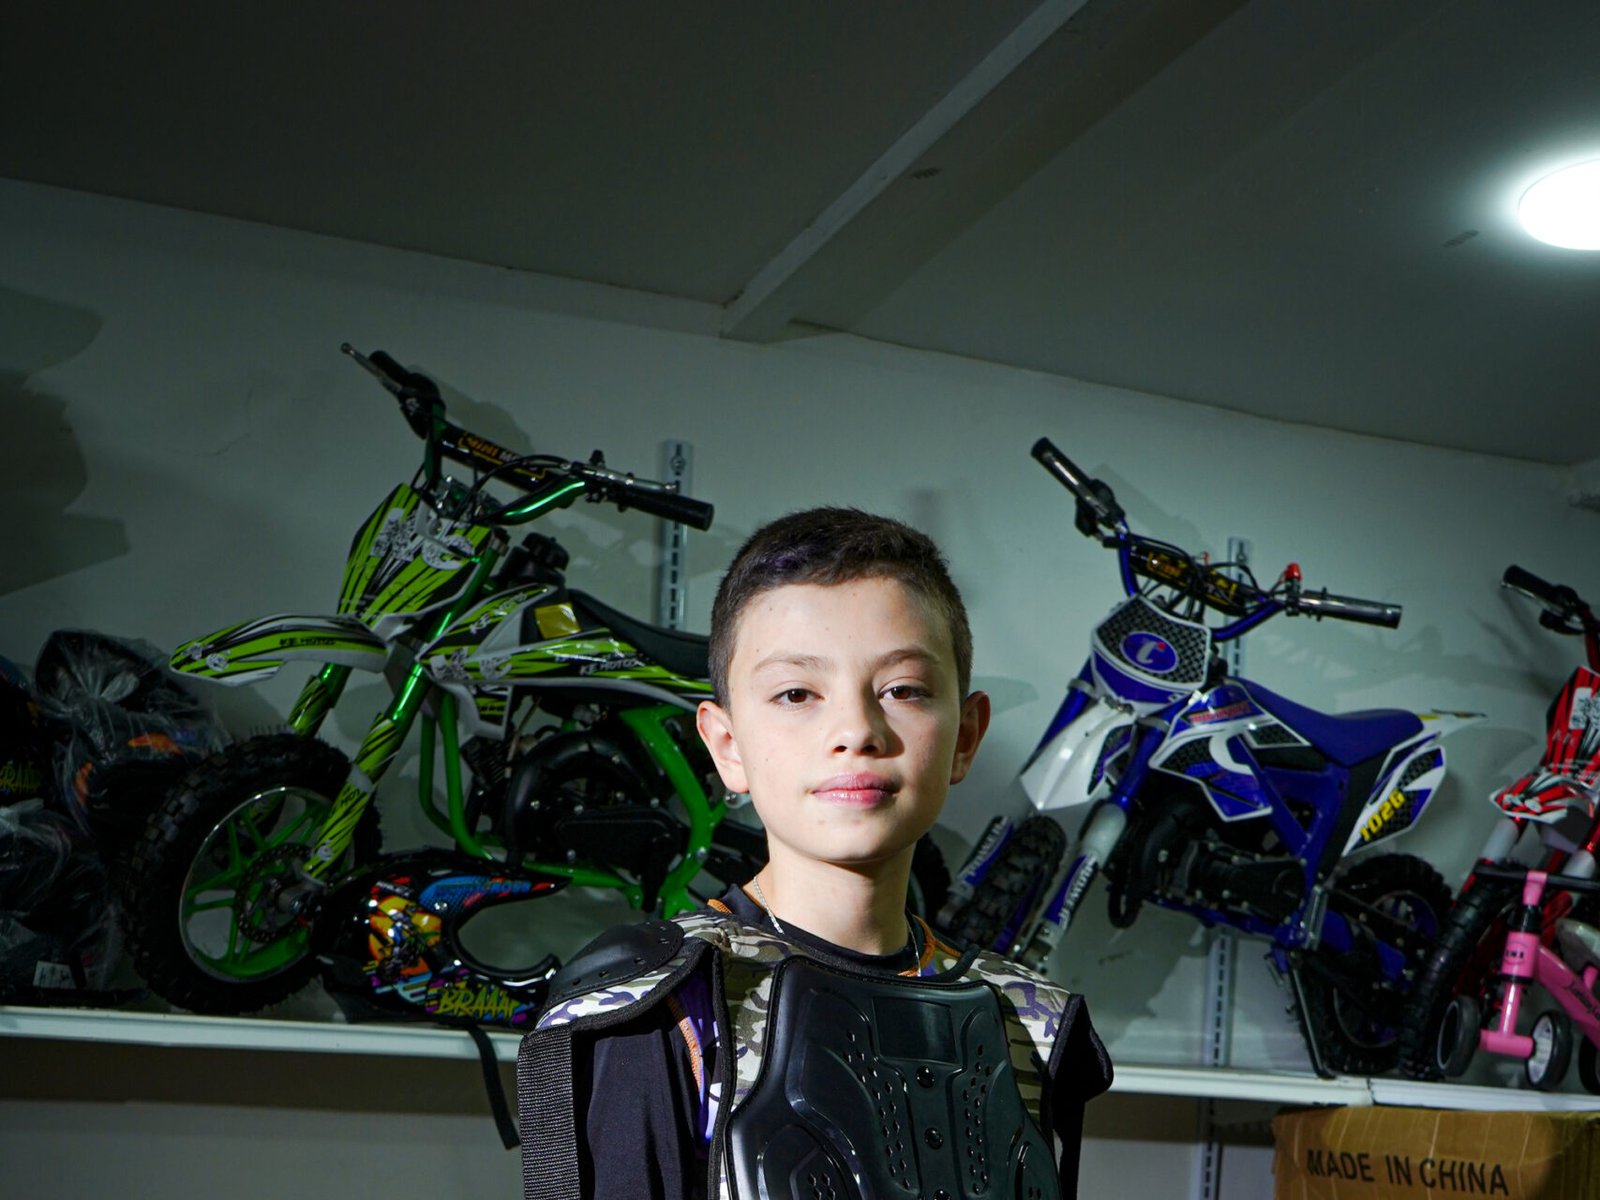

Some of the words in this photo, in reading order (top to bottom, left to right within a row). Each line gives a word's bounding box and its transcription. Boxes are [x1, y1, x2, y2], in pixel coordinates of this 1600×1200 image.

[1306, 1150, 1374, 1181] MADE
[1386, 1155, 1413, 1186] IN
[1419, 1157, 1509, 1196] CHINA
